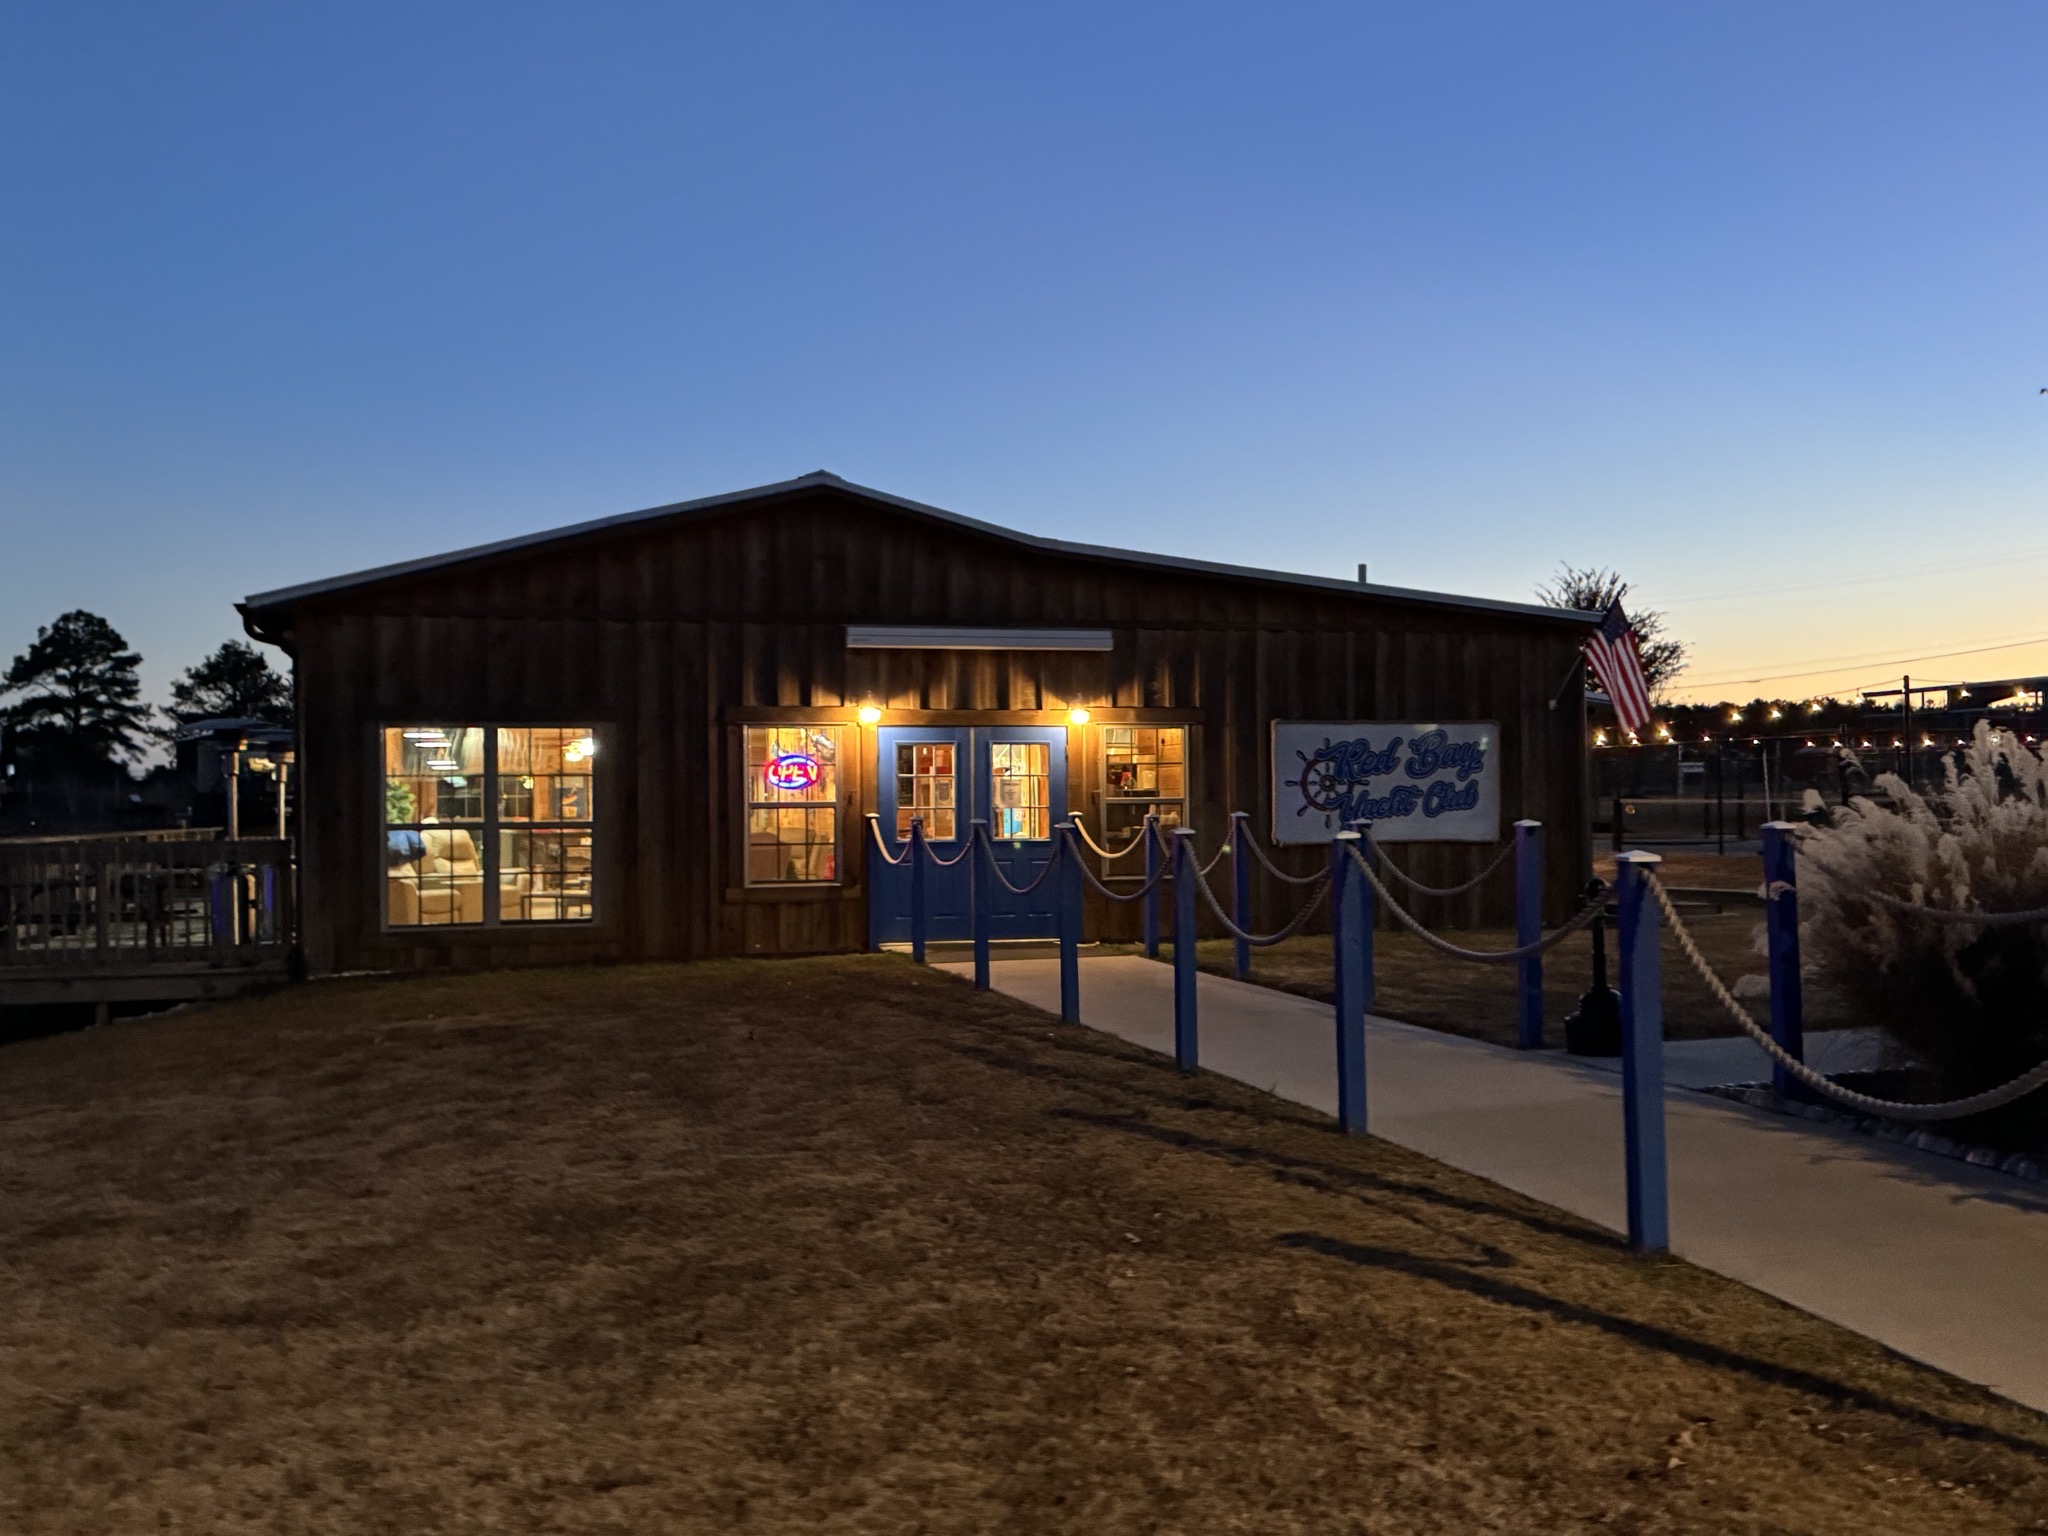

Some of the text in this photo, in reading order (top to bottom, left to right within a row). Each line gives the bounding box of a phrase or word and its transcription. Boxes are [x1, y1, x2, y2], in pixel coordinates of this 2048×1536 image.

[1314, 730, 1483, 781] Red Bay
[1325, 780, 1479, 830] Yacht Club
